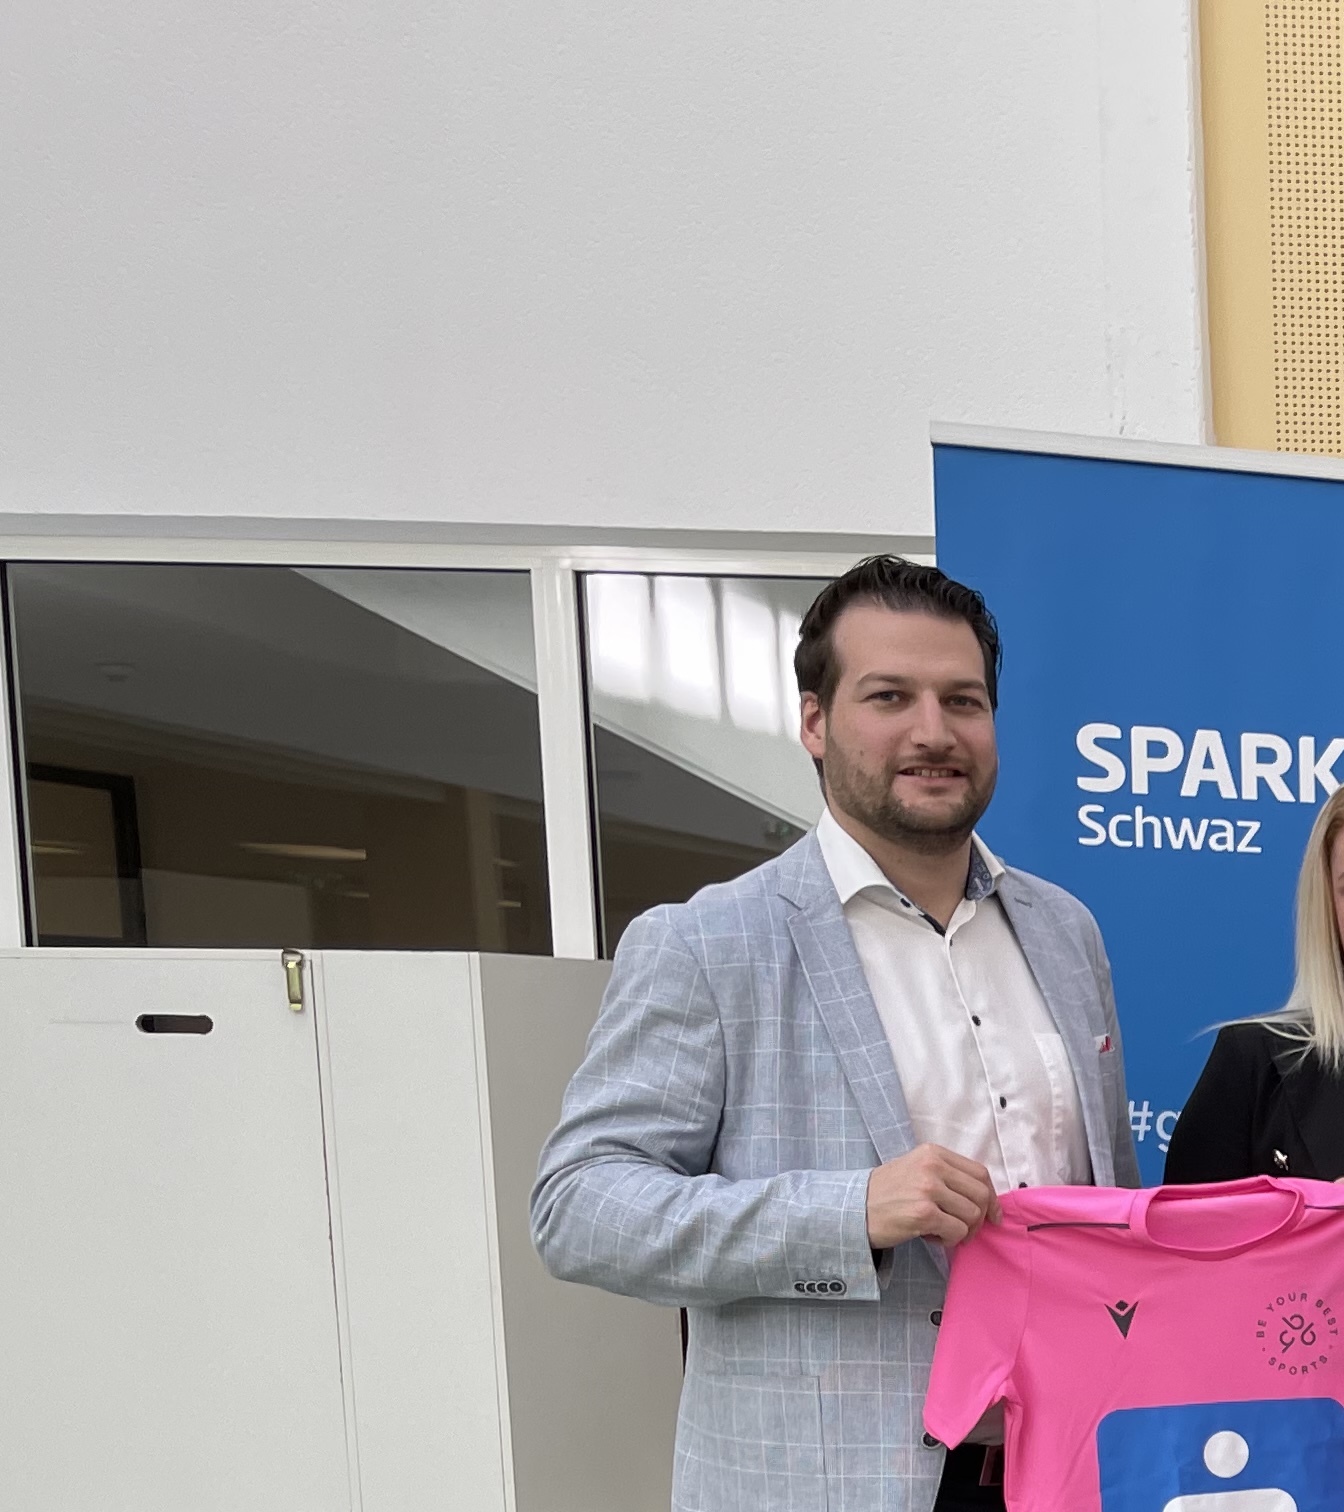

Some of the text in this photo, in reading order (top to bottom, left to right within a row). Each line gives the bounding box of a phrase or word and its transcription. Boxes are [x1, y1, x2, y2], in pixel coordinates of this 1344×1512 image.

[1078, 804, 1262, 853] Schwaz
[1256, 1292, 1339, 1338] BE YOUR BEST
[1268, 1356, 1328, 1376] SPORTS
